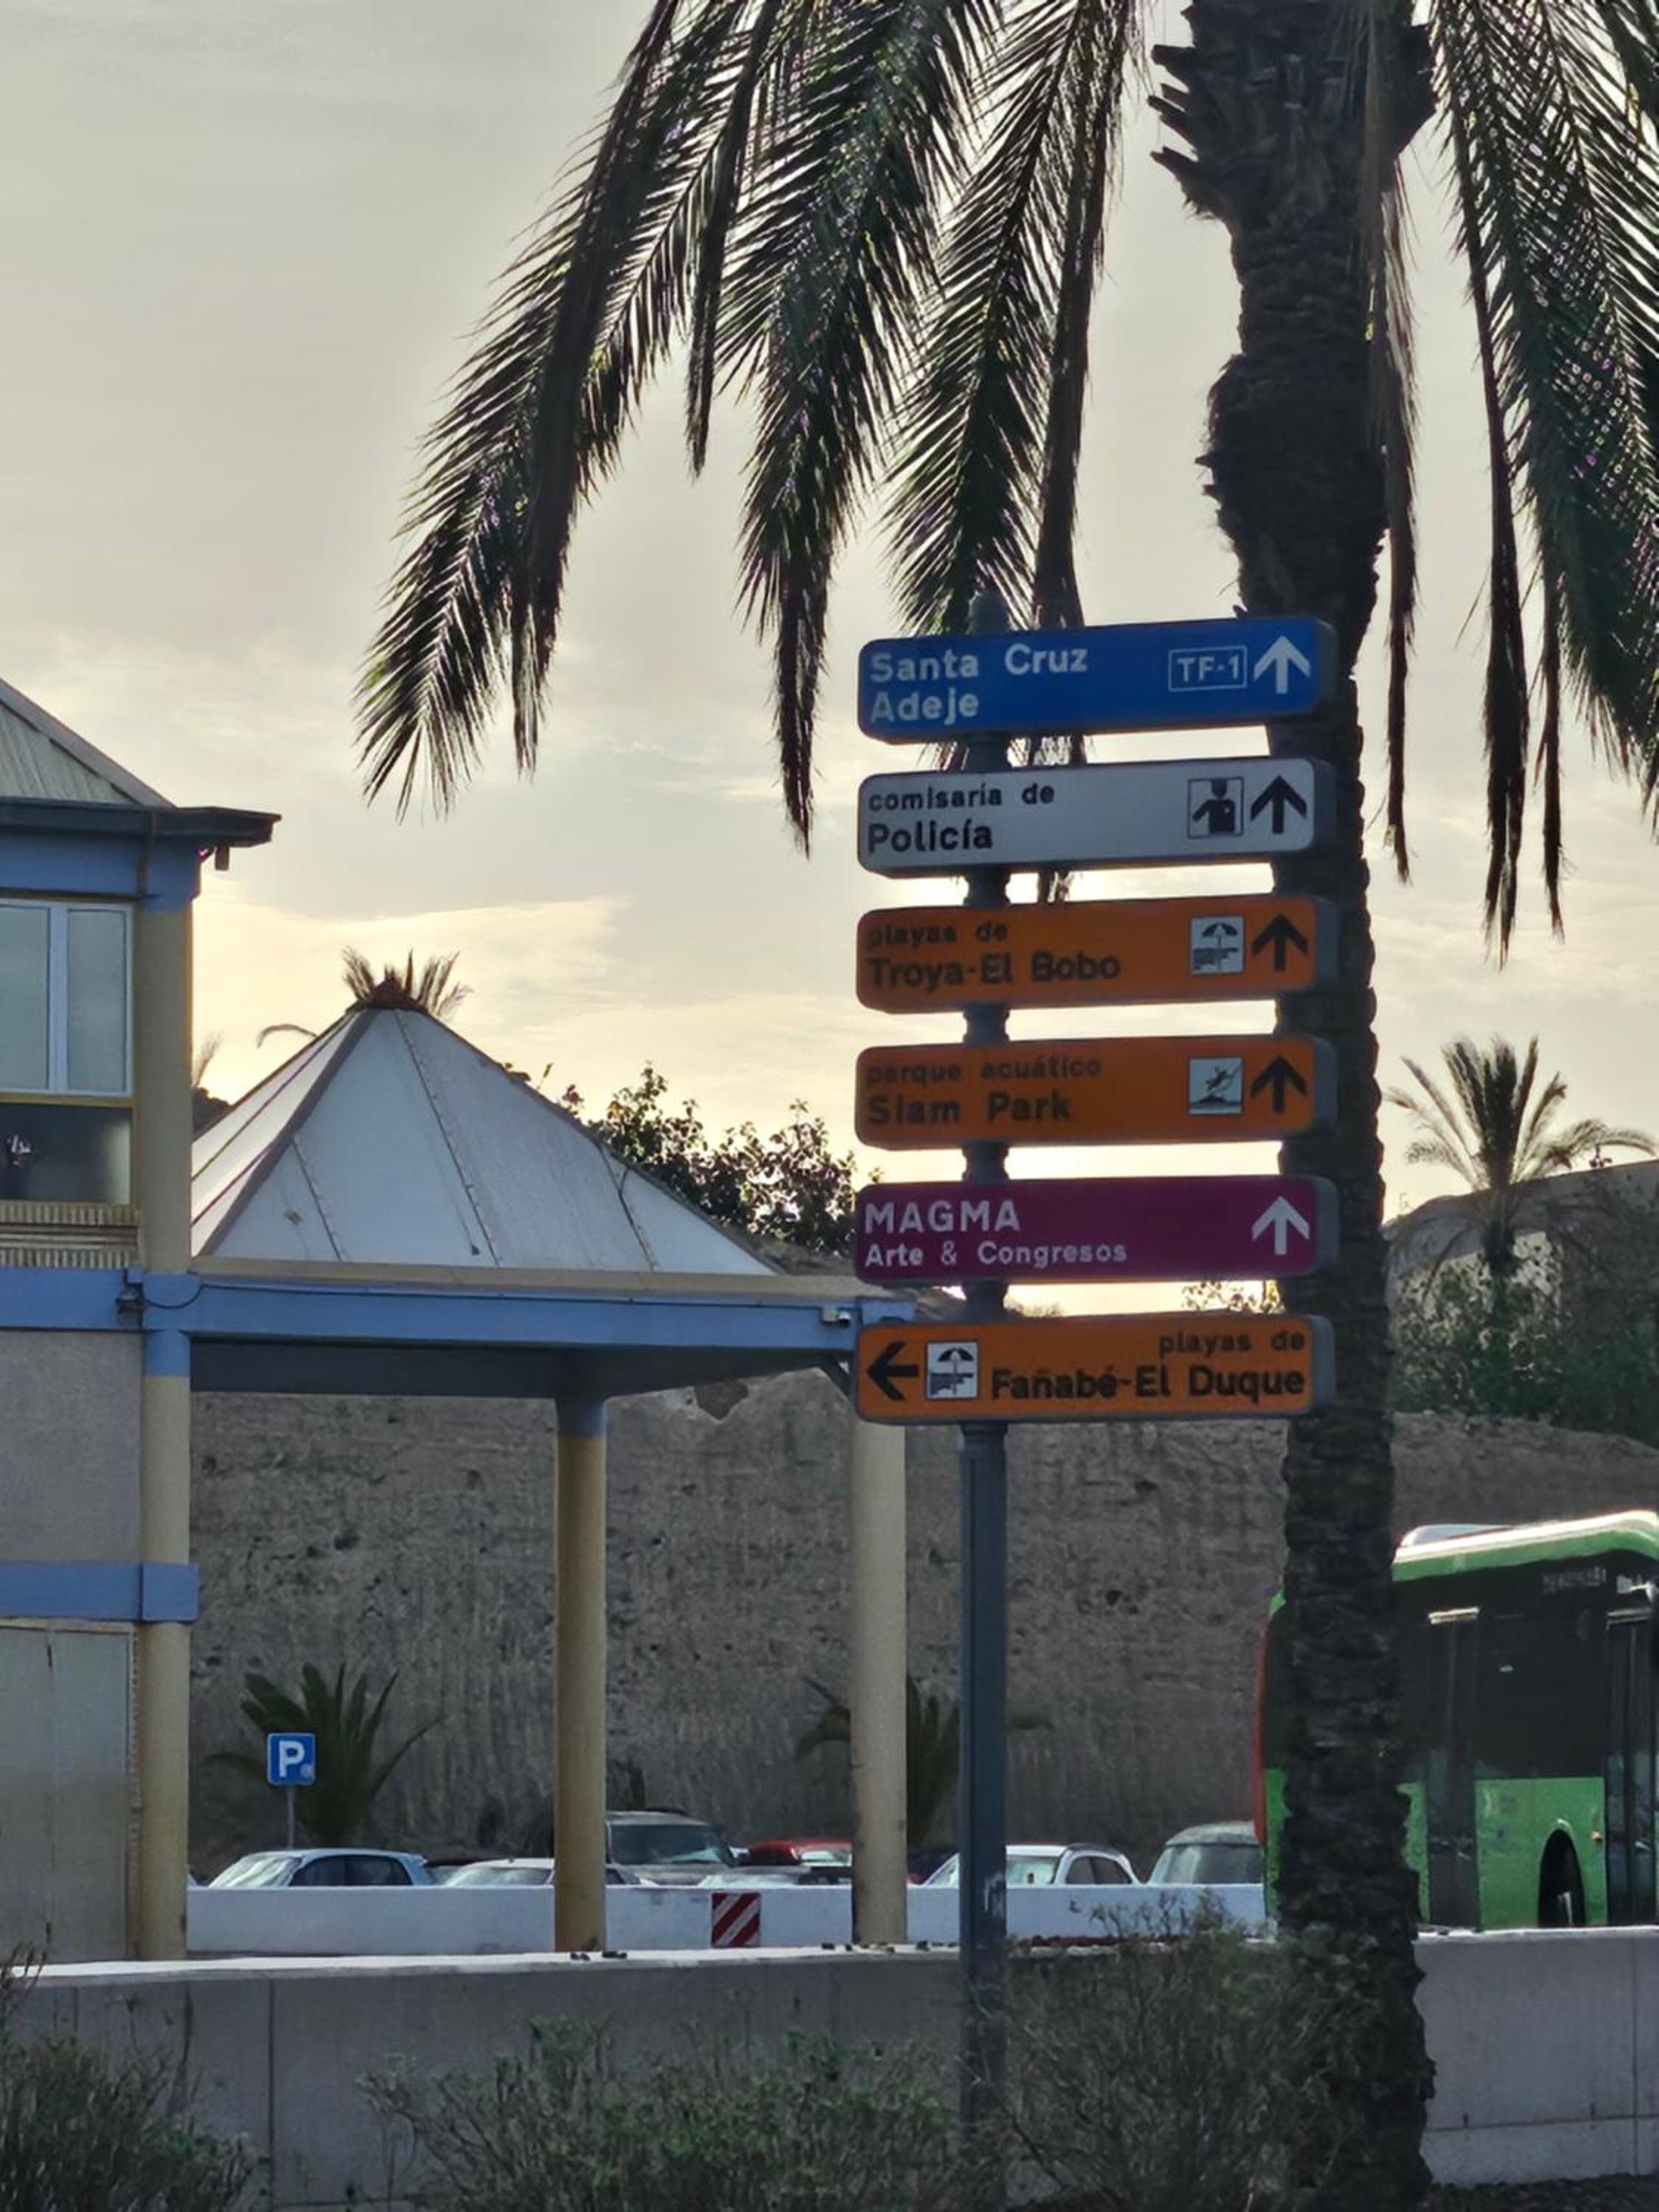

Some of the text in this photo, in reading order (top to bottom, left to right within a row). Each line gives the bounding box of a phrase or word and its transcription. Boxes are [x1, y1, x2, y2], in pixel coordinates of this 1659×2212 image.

[869, 642, 1089, 683] Santa Cruz
[1178, 654, 1239, 682] TF-1
[870, 687, 980, 726] Adeje
[869, 783, 1054, 812] comisaría de
[868, 818, 993, 854] Policía
[867, 922, 1008, 950] playas de
[869, 951, 1120, 992] Troya-El Bobo
[866, 1057, 1102, 1090] parque acuático
[869, 1088, 1071, 1125] Siam Park
[865, 1200, 1020, 1234] MAGMA
[865, 1240, 1127, 1268] Arte & Congresos
[1159, 1331, 1305, 1357] playas de
[990, 1364, 1305, 1403] Fañabé-El Duque
[279, 1741, 305, 1778] P
